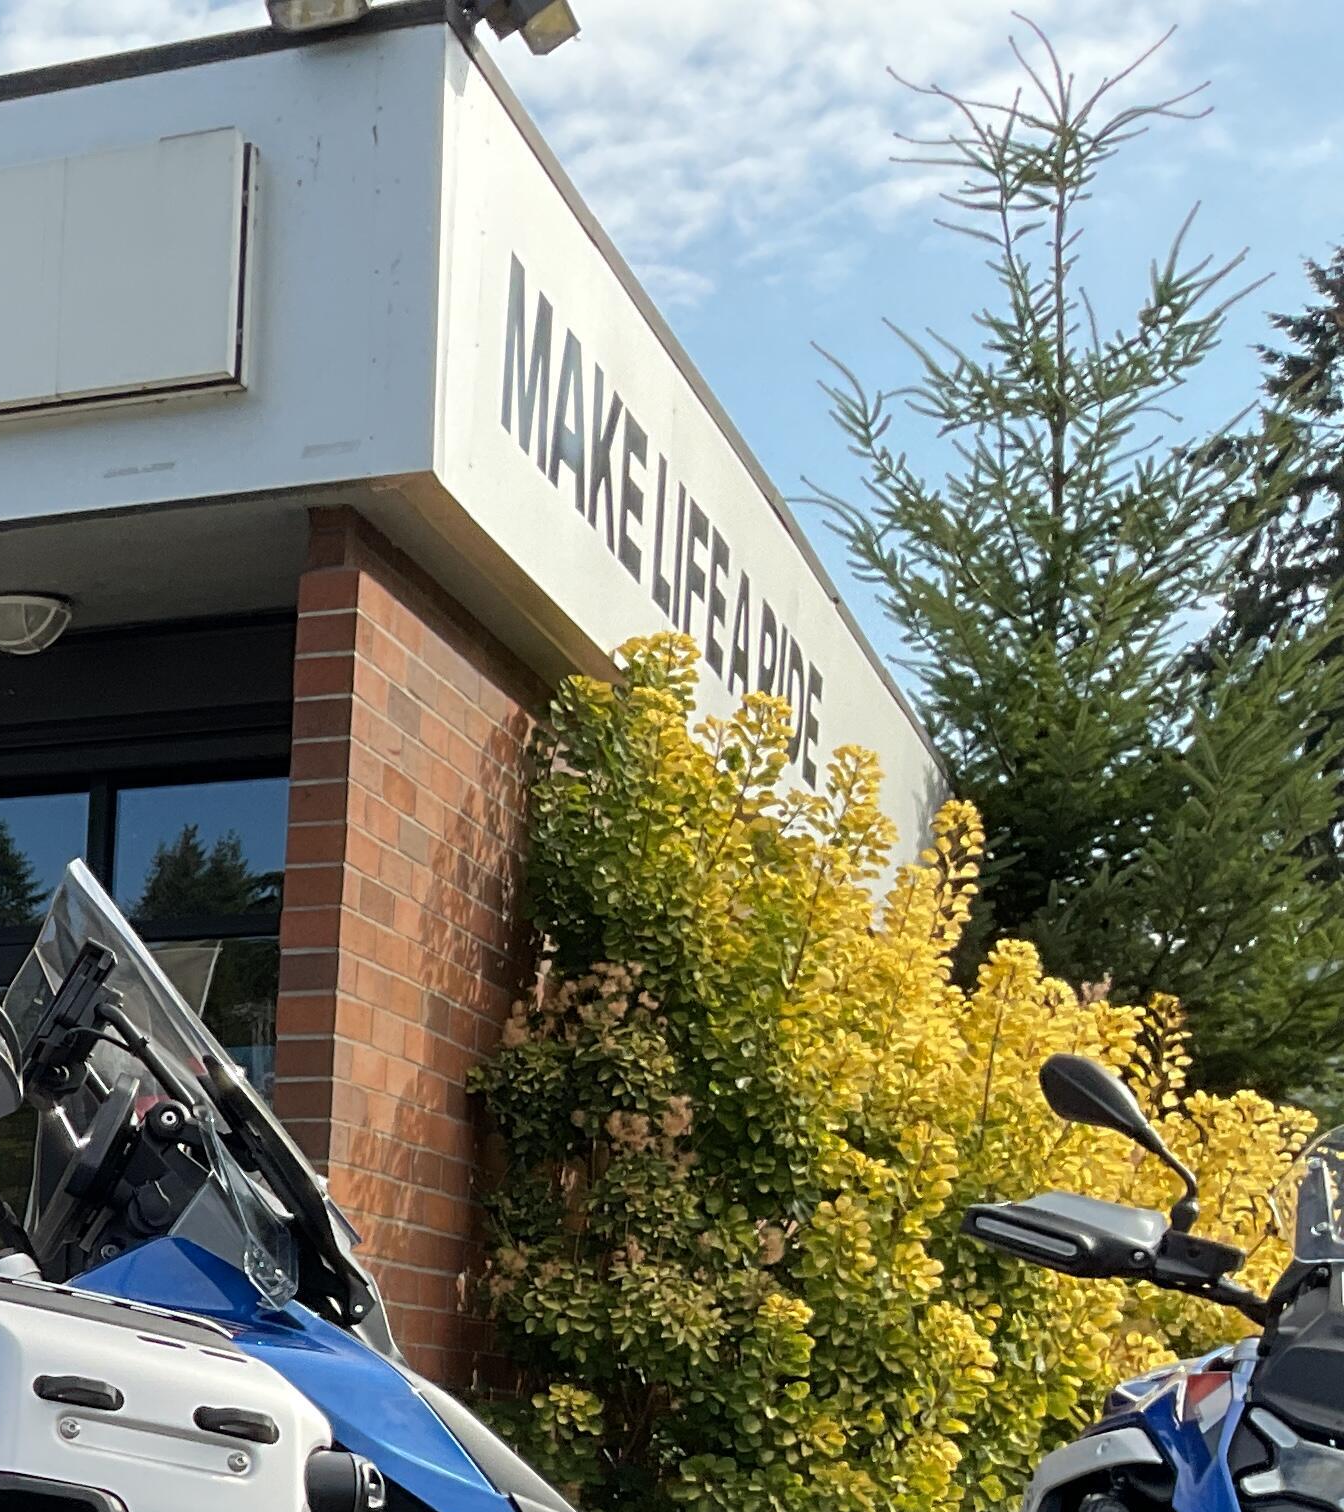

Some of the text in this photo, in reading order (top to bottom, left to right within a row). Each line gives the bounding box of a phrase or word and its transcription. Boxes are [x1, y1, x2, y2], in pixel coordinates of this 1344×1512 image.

[501, 250, 823, 792] MAKE LIFE A RIDE
